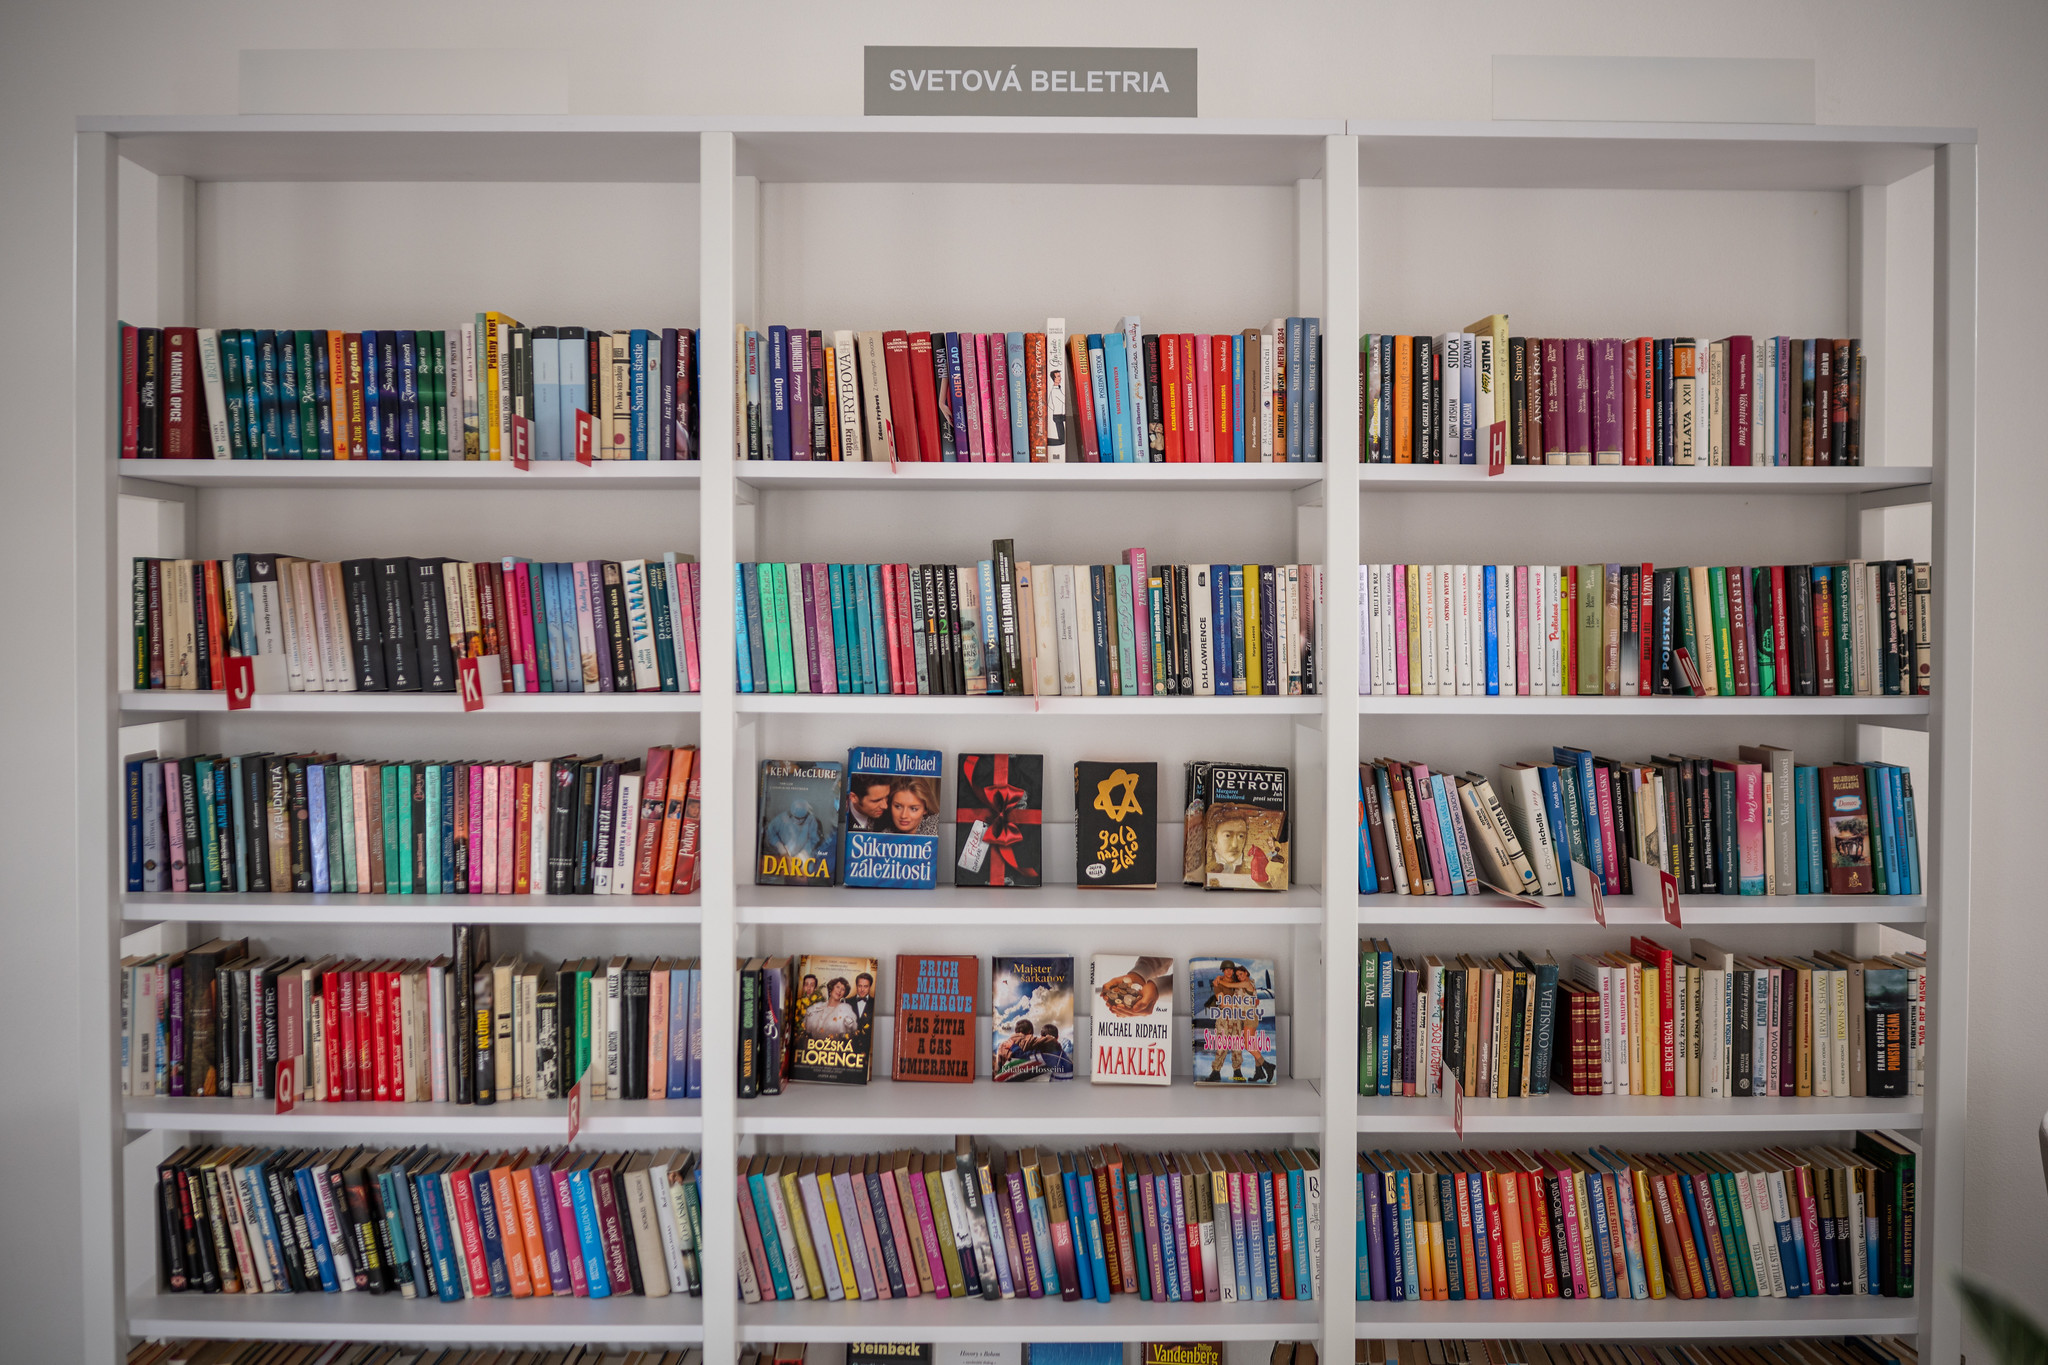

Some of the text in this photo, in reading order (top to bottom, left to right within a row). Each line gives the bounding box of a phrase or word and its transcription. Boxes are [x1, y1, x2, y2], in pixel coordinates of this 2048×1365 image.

[889, 65, 1169, 93] SVETOVÁ BELETRIA
[334, 337, 342, 385] Princezna
[486, 320, 498, 368] Púštny kvet
[1078, 340, 1088, 374] CHIRURG
[1481, 340, 1491, 374] HAILEY
[935, 348, 948, 378] KRÁSKA
[1513, 345, 1524, 381] Stratený
[1680, 351, 1688, 375] joseph
[170, 352, 183, 421] KAMENNÁ OPICE
[349, 342, 362, 442] JUDE DEVERAUX Legenda
[663, 385, 672, 405] María
[773, 378, 783, 410] OUTSIDER
[840, 353, 856, 424] FRÝBOVÁ
[1277, 373, 1285, 412] GLUKHOVSKY
[1448, 339, 1459, 438] JOHN GRISHAM SUDCA
[1463, 340, 1473, 440] JOHN GRISHAM ZOZNAM
[580, 420, 589, 454] F
[1683, 384, 1692, 458] HLAVA XXII
[517, 427, 526, 460] E
[1492, 431, 1502, 466] H
[134, 561, 145, 592] zbohom
[983, 564, 992, 594] LÁSKU
[1642, 574, 1653, 606] BLÁZON!
[135, 593, 145, 626] Posledné
[627, 565, 648, 642] VIA MALA
[936, 569, 948, 634] 2 QUEENIE
[1001, 583, 1013, 633] BÍLÍ BARONI
[1732, 573, 1744, 628] POKÁNIE
[662, 604, 672, 639] KOONTZ
[986, 614, 995, 650] VŠETKO
[1662, 606, 1671, 671] POJISTKA
[136, 636, 144, 670] Hooperová
[638, 649, 646, 664] John
[644, 648, 652, 669] Knittel
[1199, 617, 1209, 689] D.H.LAWRENCE
[234, 666, 248, 699] J
[463, 668, 479, 702] K
[770, 766, 836, 779] KEN McCLURE
[857, 752, 936, 772] Judith Michael
[1216, 771, 1283, 782] ODVIATE
[215, 770, 228, 828] ANJEL TEMNOT
[1216, 779, 1283, 791] VETROM
[1599, 773, 1611, 826] MESTO LÁSKY
[1779, 758, 1790, 826] Veľké maličkosti
[182, 774, 196, 838] RÍŠA DRAKOV
[272, 766, 284, 839] ZABUDNUTÁ
[678, 821, 696, 857] Podvody
[1098, 825, 1137, 850] gold
[1496, 810, 1515, 842] LOLITA
[205, 842, 220, 872] KRÉDO
[852, 834, 932, 860] Súkromné
[1097, 846, 1119, 861] nad
[1112, 841, 1139, 874] zlato
[763, 855, 830, 879] DARCA
[850, 858, 931, 881] záležitosti
[1665, 882, 1674, 914] P
[920, 960, 958, 976] ERICH
[1014, 964, 1051, 977] Majster
[1021, 974, 1064, 982] šarkanov
[1363, 959, 1376, 1008] PRVÝ REZ
[1380, 960, 1392, 998] DOKTORKA
[917, 977, 958, 994] MARIA
[1216, 995, 1258, 1006] JANET
[902, 994, 972, 1012] REMARQUE
[1210, 1008, 1264, 1021] DAILEY
[1538, 989, 1552, 1048] CONSUELA
[1818, 976, 1827, 1036] IRWIN SHAW
[264, 988, 276, 1060] KRSTNÝ OTEC
[476, 1009, 490, 1048] NA ÚTEKU
[907, 1013, 965, 1035] ČAS ŽITIA
[1098, 1022, 1167, 1038] MICHAEL RIDPATH
[1203, 1029, 1271, 1052] Strieborné krídla
[794, 1050, 864, 1068] FLORENCE
[807, 1038, 853, 1052] BOŽSKÁ
[918, 1034, 952, 1055] A ČAS
[1664, 1019, 1674, 1072] ERICH SEGAL
[1770, 1030, 1779, 1079] SEXTONOVÁ
[1875, 1013, 1886, 1071] FRANK SCHÄTZING
[1884, 1013, 1901, 1071] POMSTA OCEÁNA
[900, 1059, 968, 1076] UMIERANIA
[1098, 1043, 1166, 1077] MAKLÉR
[280, 1067, 291, 1102] Q
[497, 1176, 516, 1234] DIVOKÁ JAZMÍNA
[560, 1179, 571, 1207] ADORA
[1458, 1177, 1470, 1228] PRECITNUTIE
[479, 1182, 496, 1239] OSAMELÉ SRDCE
[293, 1214, 318, 1278] Sidney Sheldon
[1158, 1180, 1180, 1299] DANIELLE STEELOVÁ OCKO
[1264, 1179, 1280, 1294] KRIŽOVATKY DANIELLE STEEL
[852, 1342, 920, 1357] Steinbeck
[1154, 1345, 1219, 1365] Vandenberg
